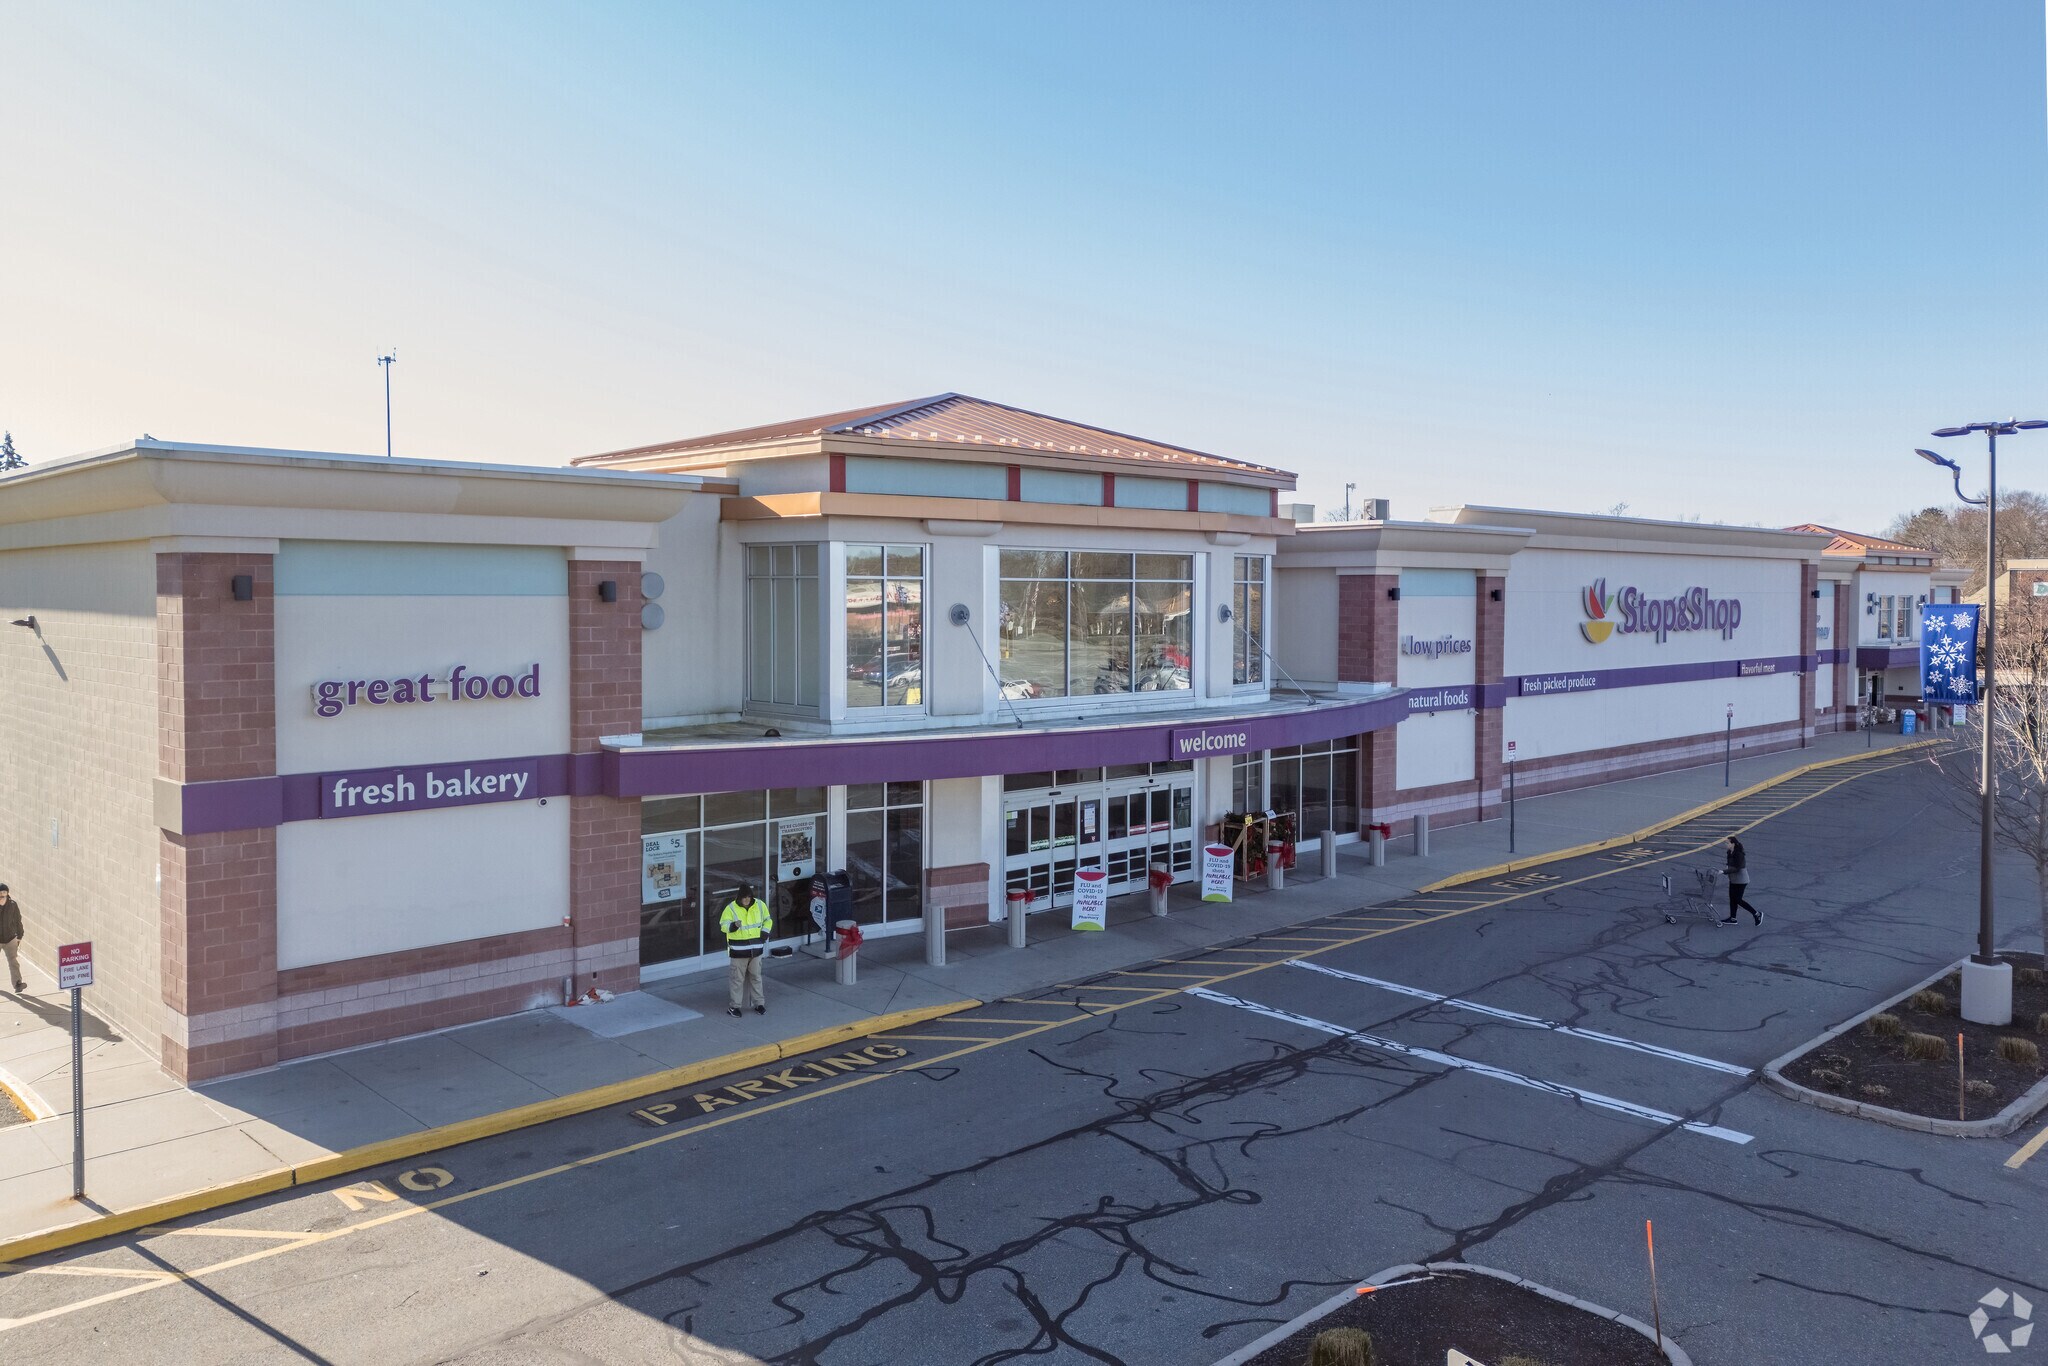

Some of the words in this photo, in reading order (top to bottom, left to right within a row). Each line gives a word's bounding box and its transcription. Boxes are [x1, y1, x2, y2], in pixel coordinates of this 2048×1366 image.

[1622, 586, 1742, 643] Stop&Shop
[1409, 635, 1432, 655] low
[1435, 634, 1471, 659] prices
[1741, 662, 1762, 675] flavorful
[1763, 664, 1775, 673] meat
[315, 673, 436, 718] great
[448, 663, 541, 701] food
[1523, 678, 1542, 692] fresh
[1543, 676, 1567, 693] picked
[1567, 674, 1596, 692] produce
[1408, 691, 1442, 708] natural
[1443, 689, 1469, 706] foods
[1179, 730, 1247, 753] welcome
[333, 773, 416, 808] fresh
[426, 769, 529, 798] bakery
[1490, 872, 1562, 890] FIRE
[1596, 847, 1664, 863] LANE
[62, 954, 89, 963] PARKING
[332, 1167, 455, 1211] NO
[633, 1042, 908, 1126] PARKING
